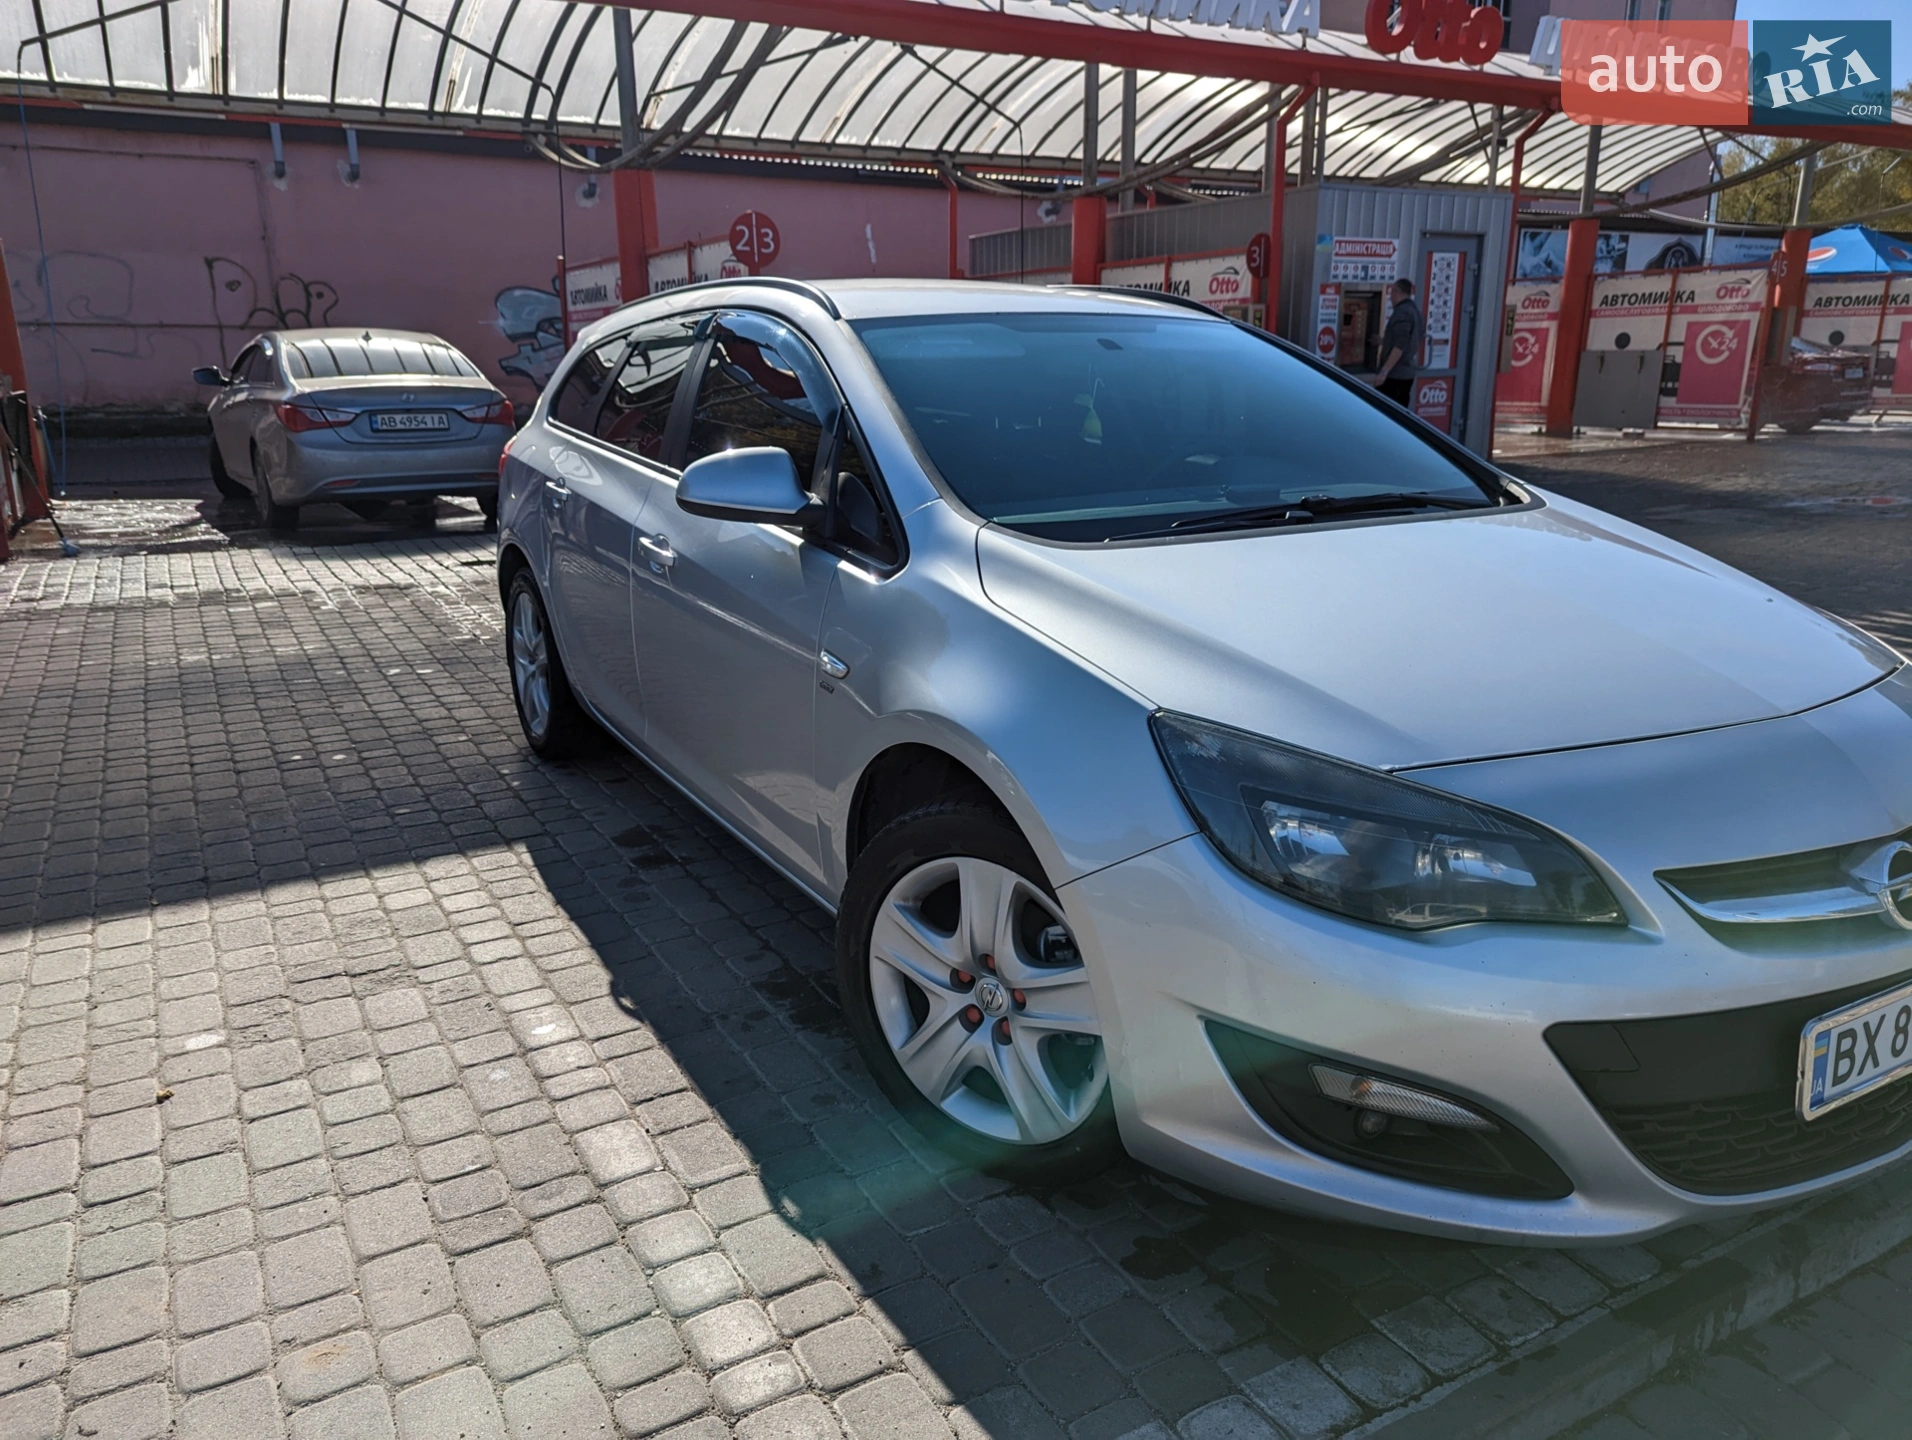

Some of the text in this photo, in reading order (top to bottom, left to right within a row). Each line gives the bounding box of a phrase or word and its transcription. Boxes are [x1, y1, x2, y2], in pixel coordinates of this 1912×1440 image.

[1365, 0, 1504, 65] Otto
[735, 225, 775, 254] 2 3
[1250, 245, 1261, 268] 3
[1333, 242, 1395, 255] АДМІНІСТРАЦІЯ
[1771, 260, 1788, 278] 4 5
[1208, 276, 1239, 295] Otto
[1716, 285, 1750, 300] Otto
[1521, 296, 1550, 310] Otto
[1721, 336, 1739, 350] 24
[1419, 387, 1448, 404] Otto
[380, 415, 446, 428] AB 4954 IA
[1831, 1004, 1912, 1088] BX 8
